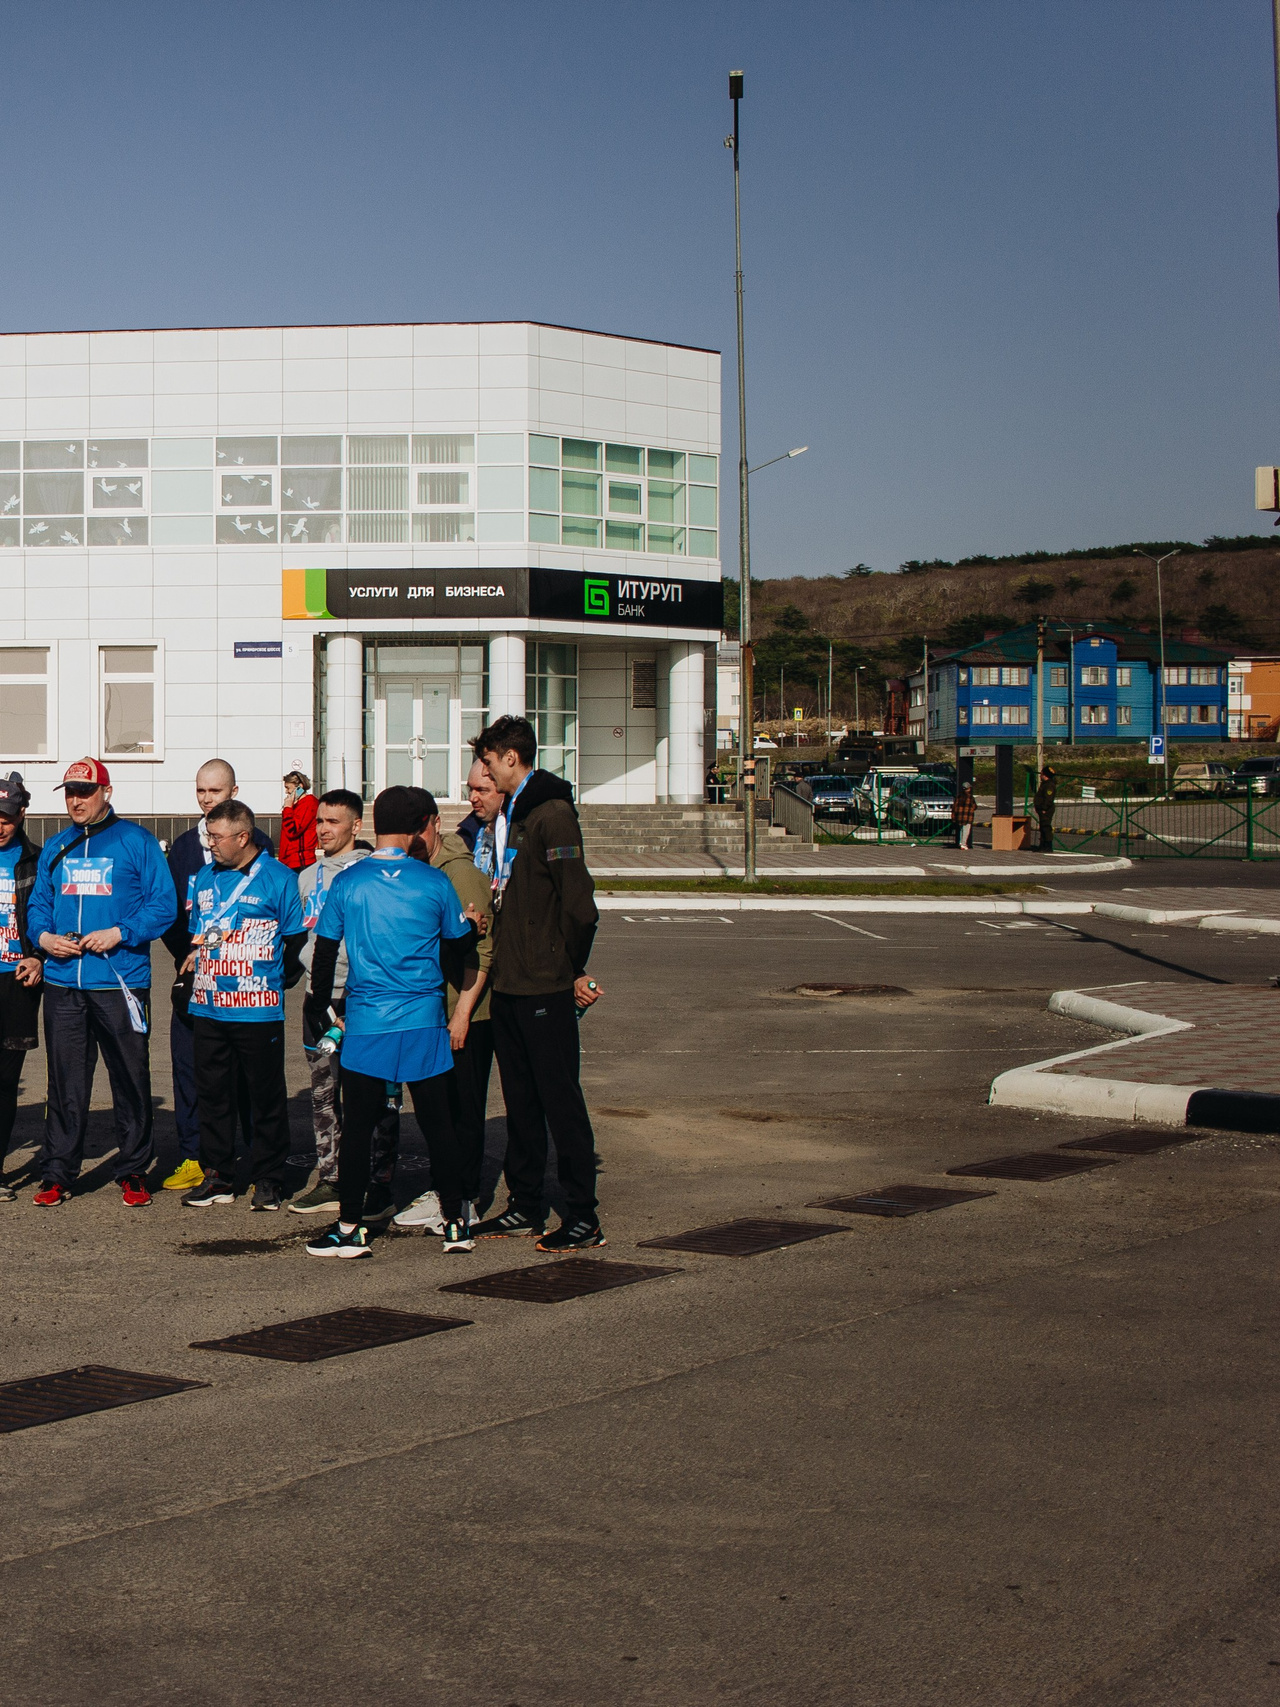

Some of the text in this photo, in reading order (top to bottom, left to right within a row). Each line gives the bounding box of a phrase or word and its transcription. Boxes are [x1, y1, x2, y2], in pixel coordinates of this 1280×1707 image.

[349, 586, 505, 599] УСЛУГИ ДЛЯ БИЗНЕСА
[618, 580, 682, 602] ИТУРУП
[618, 603, 645, 617] БАНК
[1151, 737, 1162, 754] P
[72, 869, 101, 883] 30015
[219, 943, 275, 961] #МОМЕНТ
[237, 976, 269, 992] 2024
[212, 990, 280, 1008] #ЕДИНСТВО
